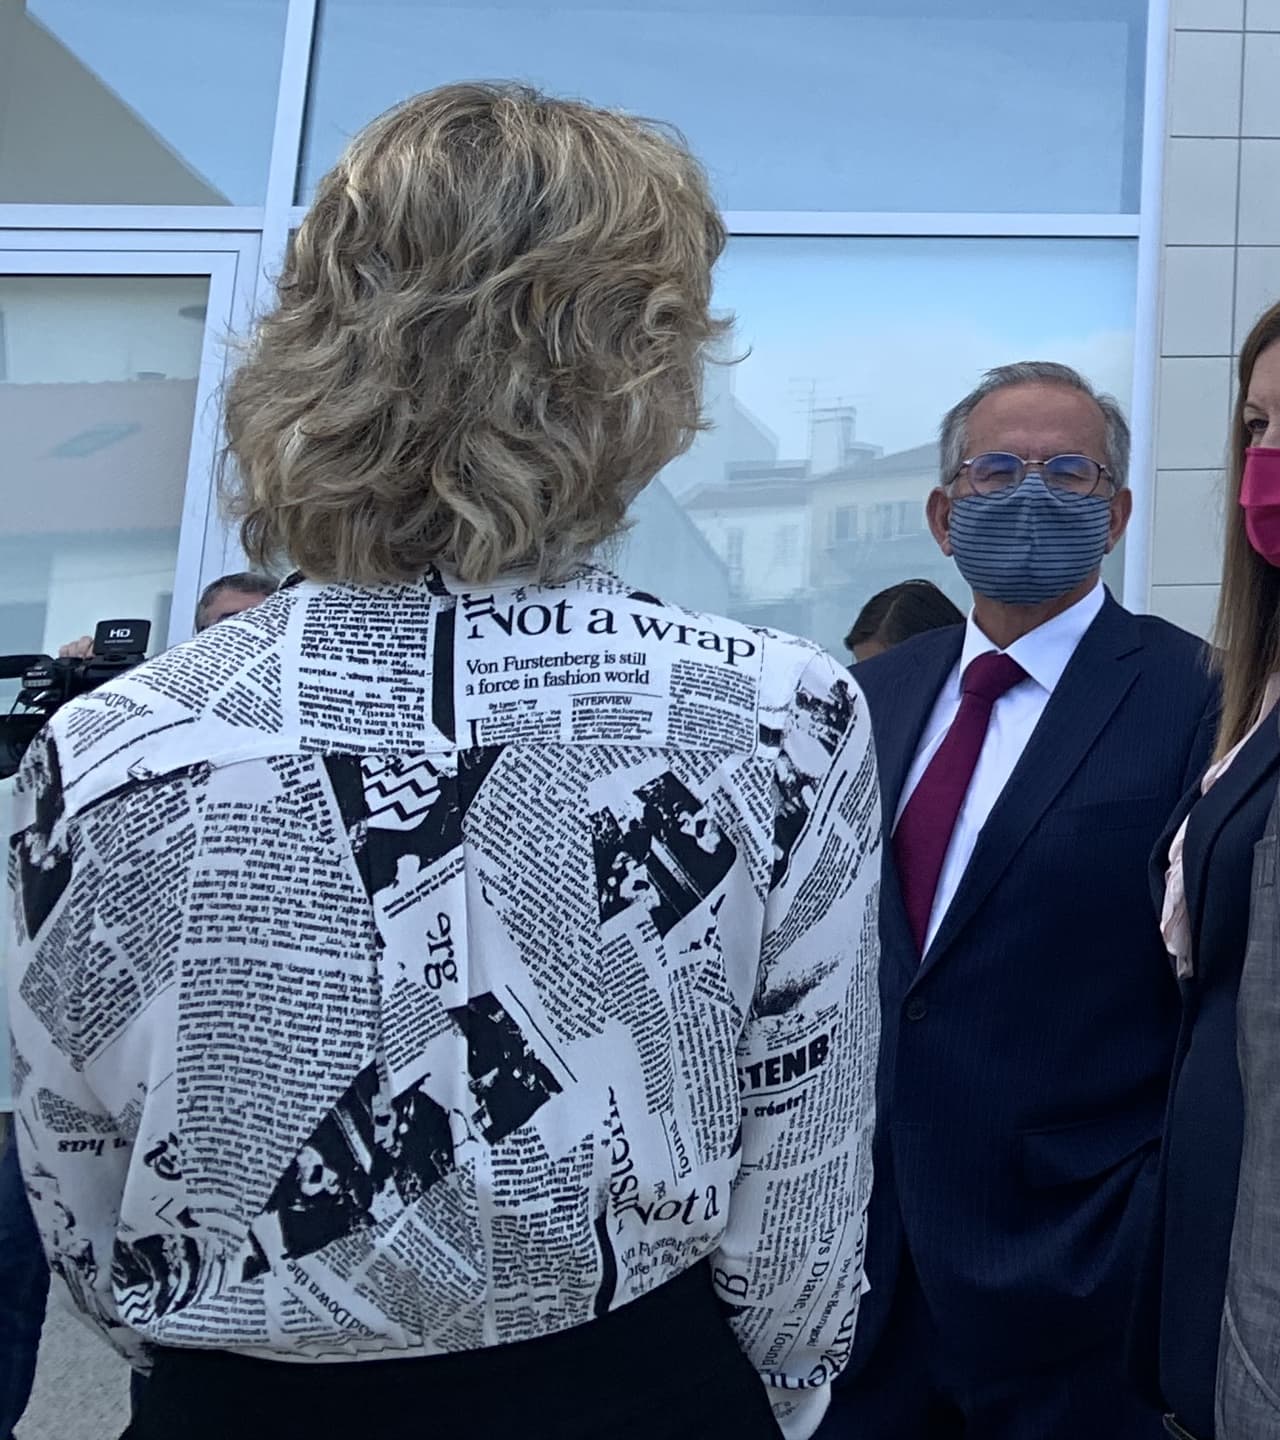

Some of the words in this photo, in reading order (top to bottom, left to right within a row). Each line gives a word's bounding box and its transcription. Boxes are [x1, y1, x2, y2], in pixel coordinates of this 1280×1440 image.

[109, 628, 131, 638] HD
[587, 607, 618, 635] a
[631, 613, 756, 666] wrap
[466, 659, 499, 676] Von
[502, 651, 600, 672] Furstenberg
[604, 650, 616, 664] is
[619, 652, 647, 666] still
[465, 683, 475, 696] a
[478, 678, 520, 695] force
[523, 674, 539, 689] in
[543, 669, 601, 688] fashion
[604, 668, 650, 685] world
[572, 695, 633, 708] INTERVIEW
[737, 1024, 836, 1094] STENB
[57, 1138, 104, 1157] has
[704, 1185, 720, 1221] a
[286, 1262, 309, 1286] the
[308, 1282, 351, 1327] Down
